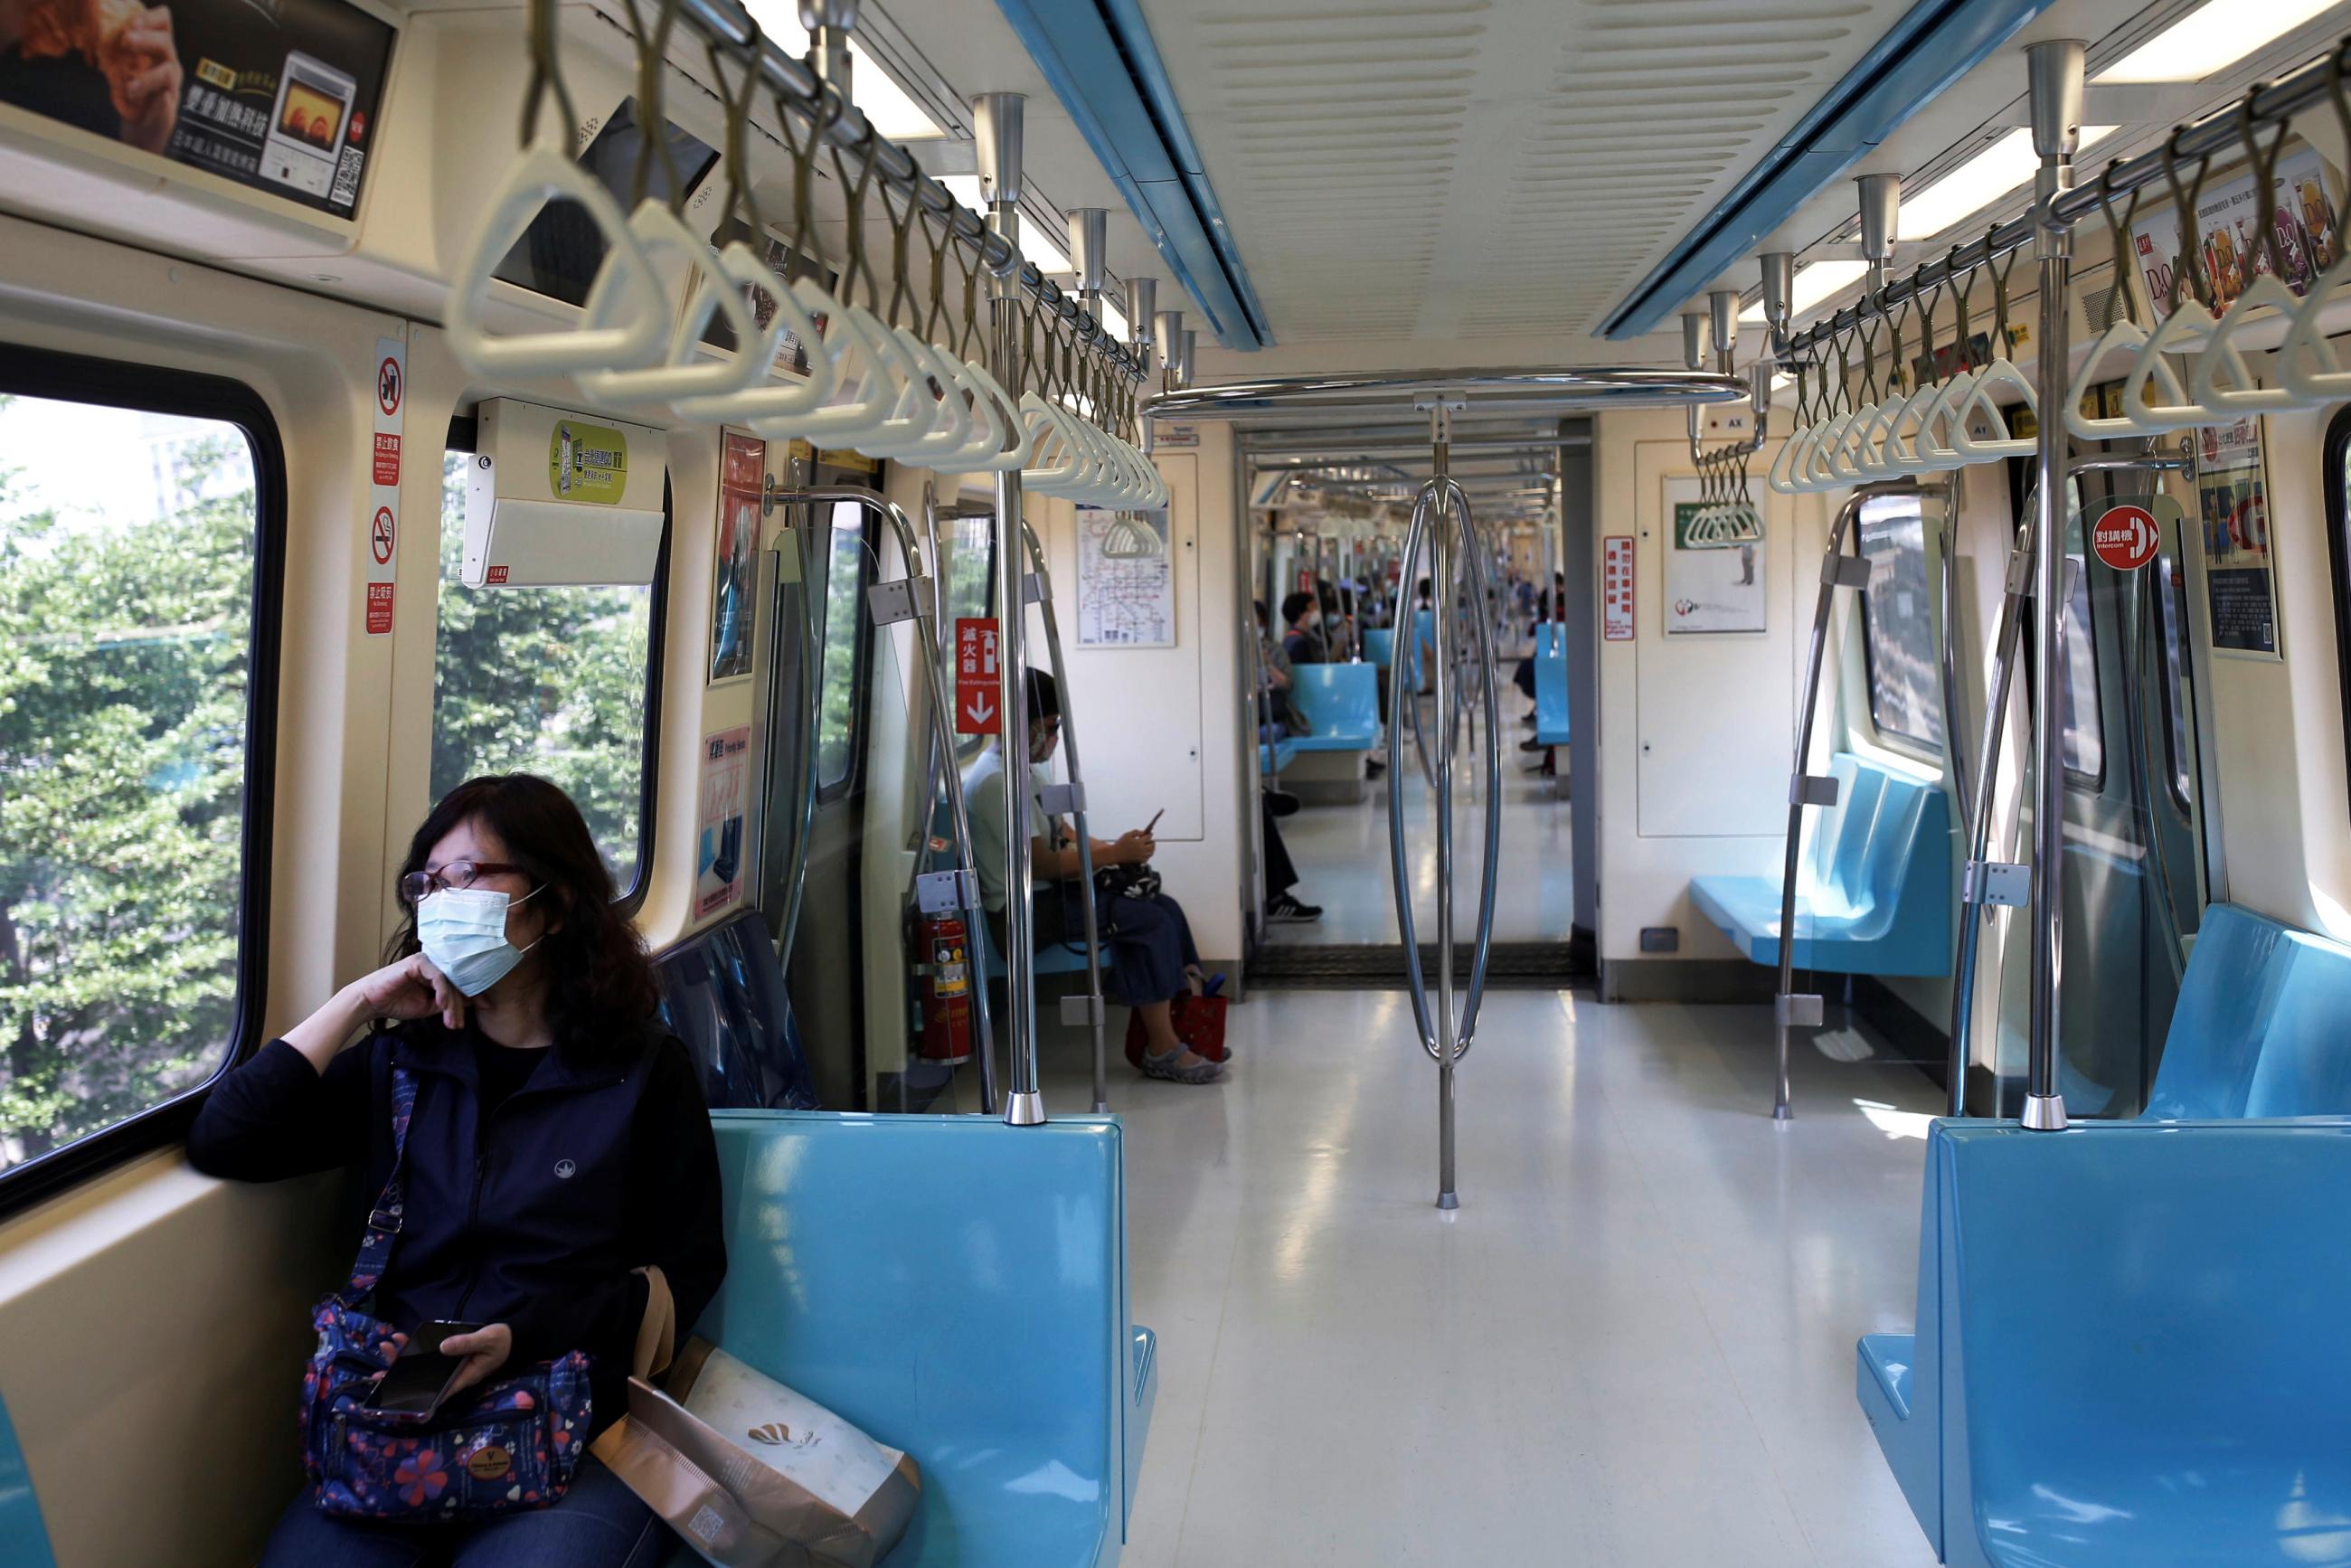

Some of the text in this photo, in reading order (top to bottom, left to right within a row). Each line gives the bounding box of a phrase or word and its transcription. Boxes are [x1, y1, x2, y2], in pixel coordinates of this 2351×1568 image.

[1728, 418, 1742, 428] AX
[375, 436, 399, 451] 禁止飲食
[2096, 529, 2133, 543] 對講機
[962, 627, 977, 674] 滅火器
